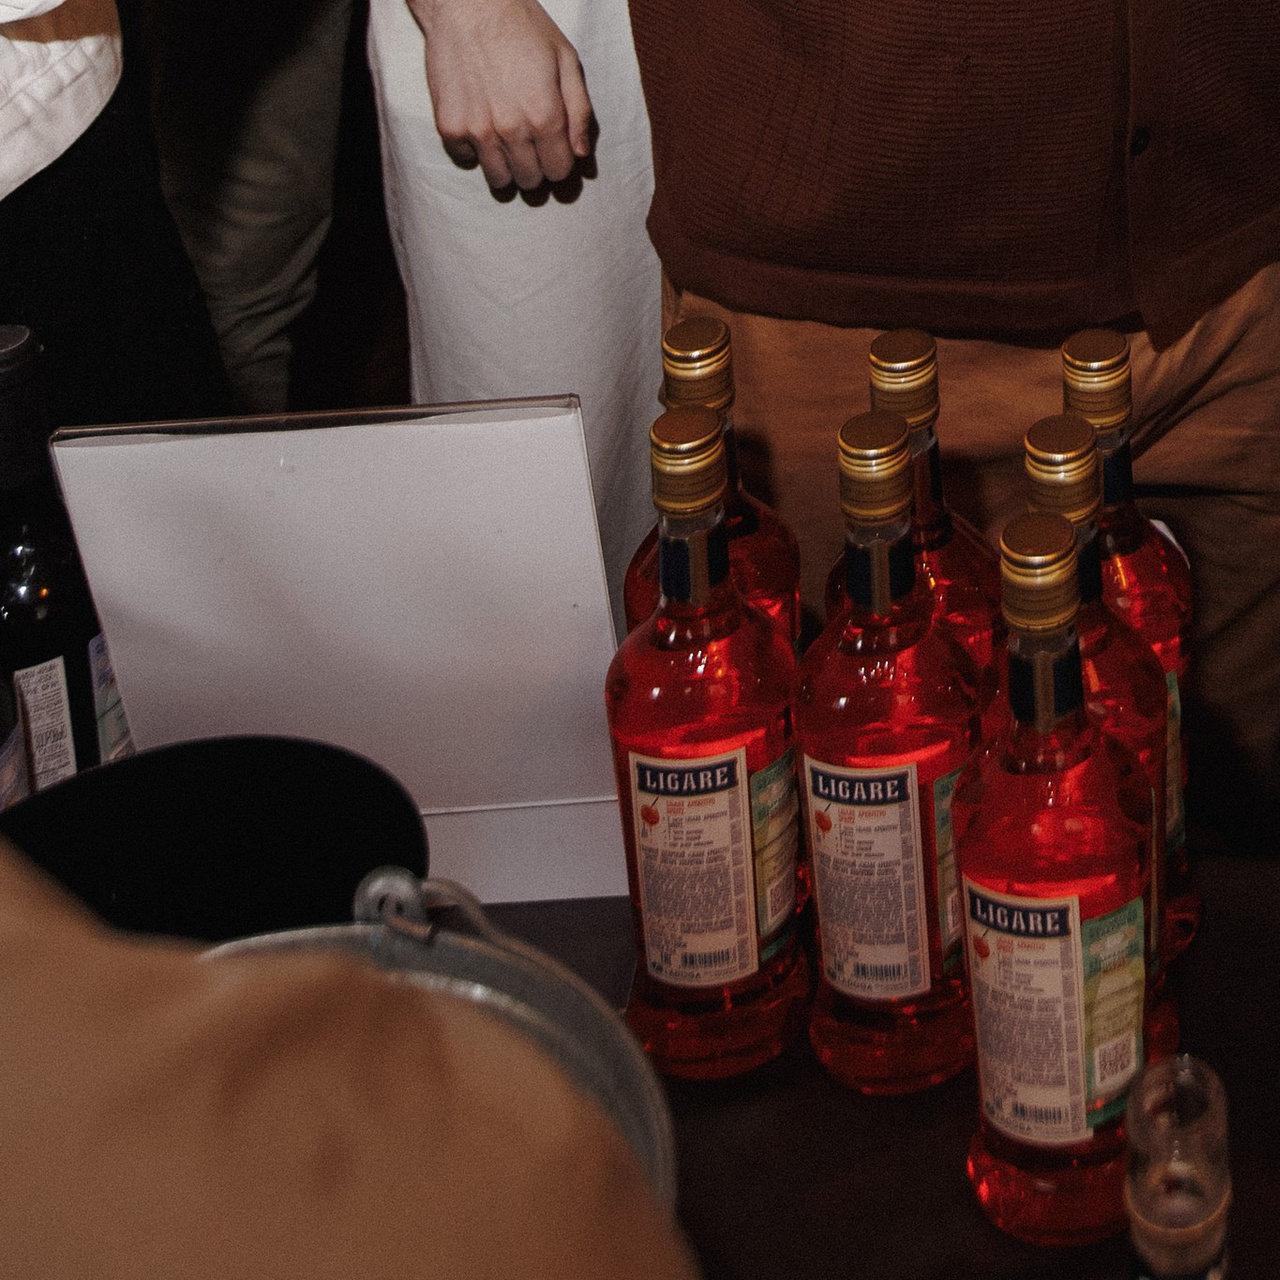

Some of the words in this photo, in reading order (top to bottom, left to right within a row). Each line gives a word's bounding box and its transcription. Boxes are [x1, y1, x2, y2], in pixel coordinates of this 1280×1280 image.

[645, 766, 729, 791] LIGARE
[817, 775, 900, 800] LIGARE
[974, 897, 1061, 934] LIGARE
